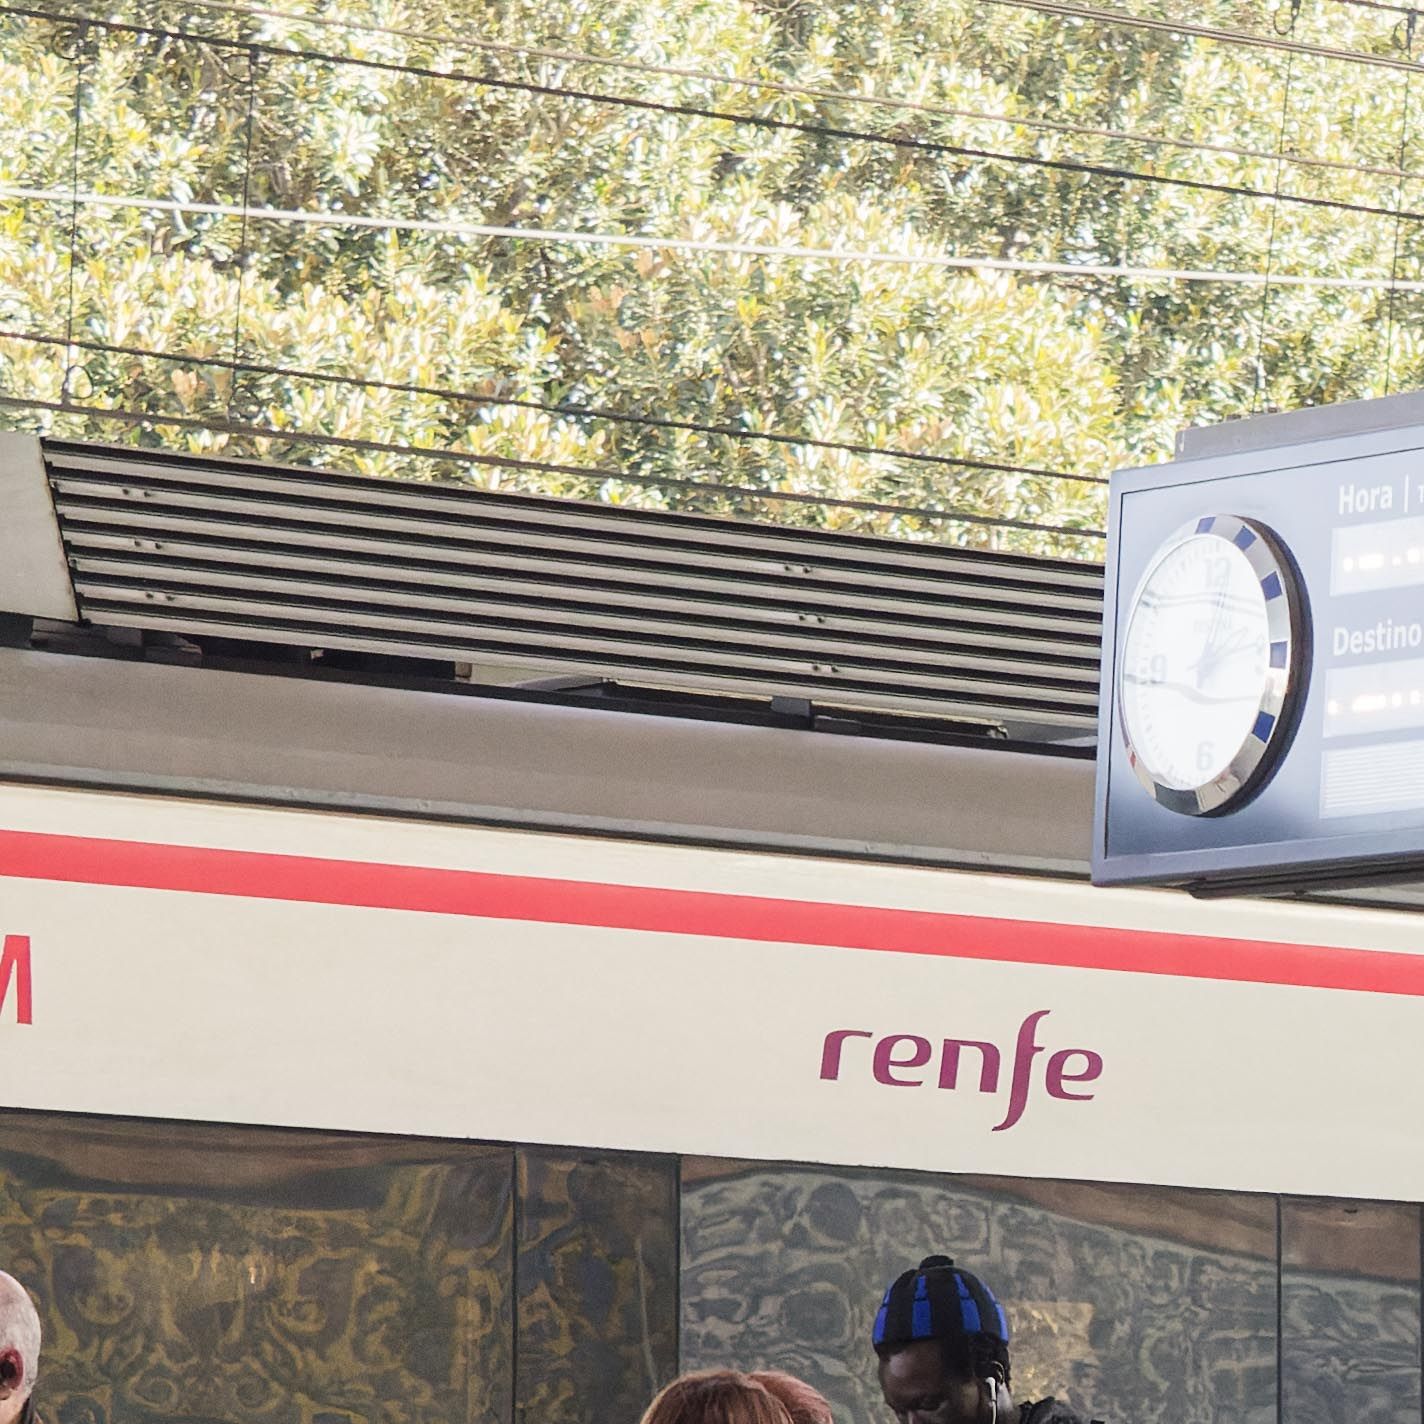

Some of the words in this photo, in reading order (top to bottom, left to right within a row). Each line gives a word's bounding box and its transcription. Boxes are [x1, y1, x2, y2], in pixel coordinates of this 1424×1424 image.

[1338, 484, 1393, 515] Hora
[1332, 619, 1422, 656] Destino
[819, 1009, 1104, 1132] renfe
